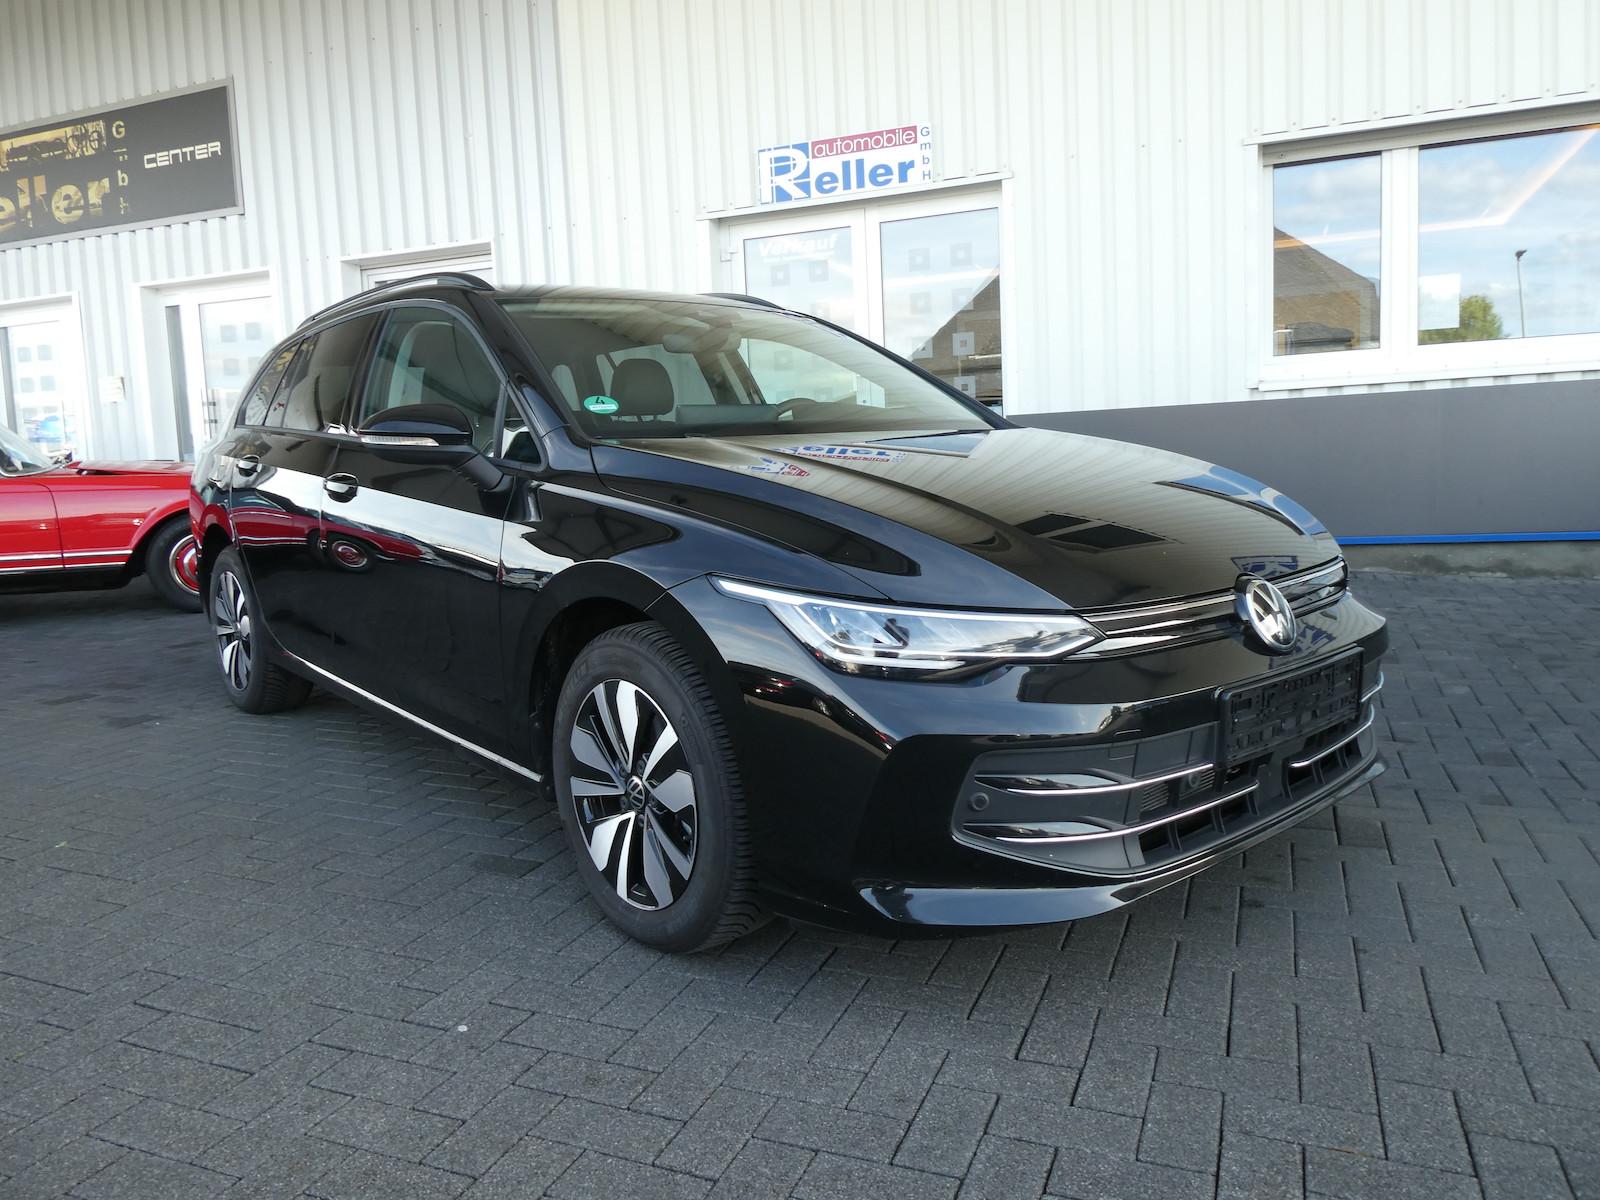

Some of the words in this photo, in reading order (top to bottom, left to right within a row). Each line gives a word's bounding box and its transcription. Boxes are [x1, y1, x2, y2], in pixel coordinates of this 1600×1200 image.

[143, 141, 222, 169] CENTER
[814, 127, 916, 158] automobile
[920, 126, 932, 181] GmbH
